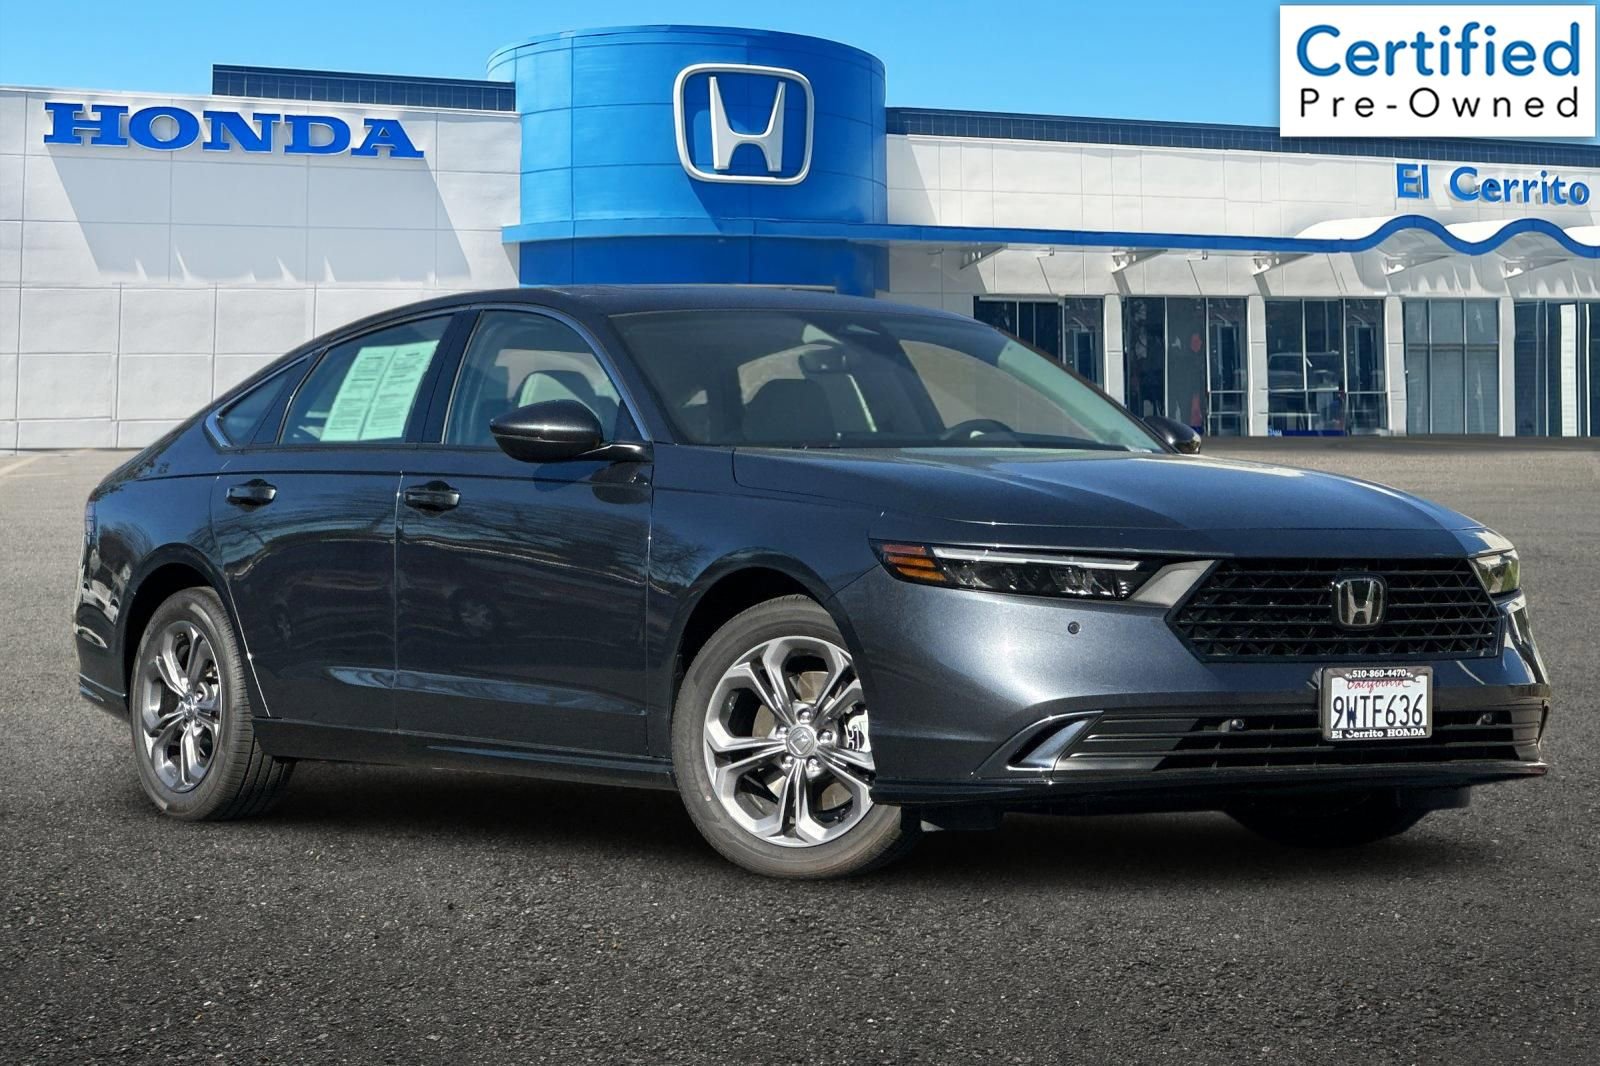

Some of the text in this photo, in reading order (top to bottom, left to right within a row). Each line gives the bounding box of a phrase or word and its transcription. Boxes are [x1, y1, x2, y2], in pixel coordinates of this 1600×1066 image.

[44, 102, 425, 159] HONDA
[1396, 163, 1590, 206] El Cerrito
[1352, 669, 1406, 677] 510-860-4470
[1333, 694, 1423, 728] 9WTF636
[1331, 730, 1342, 738] El
[1387, 728, 1425, 737] HONDA
